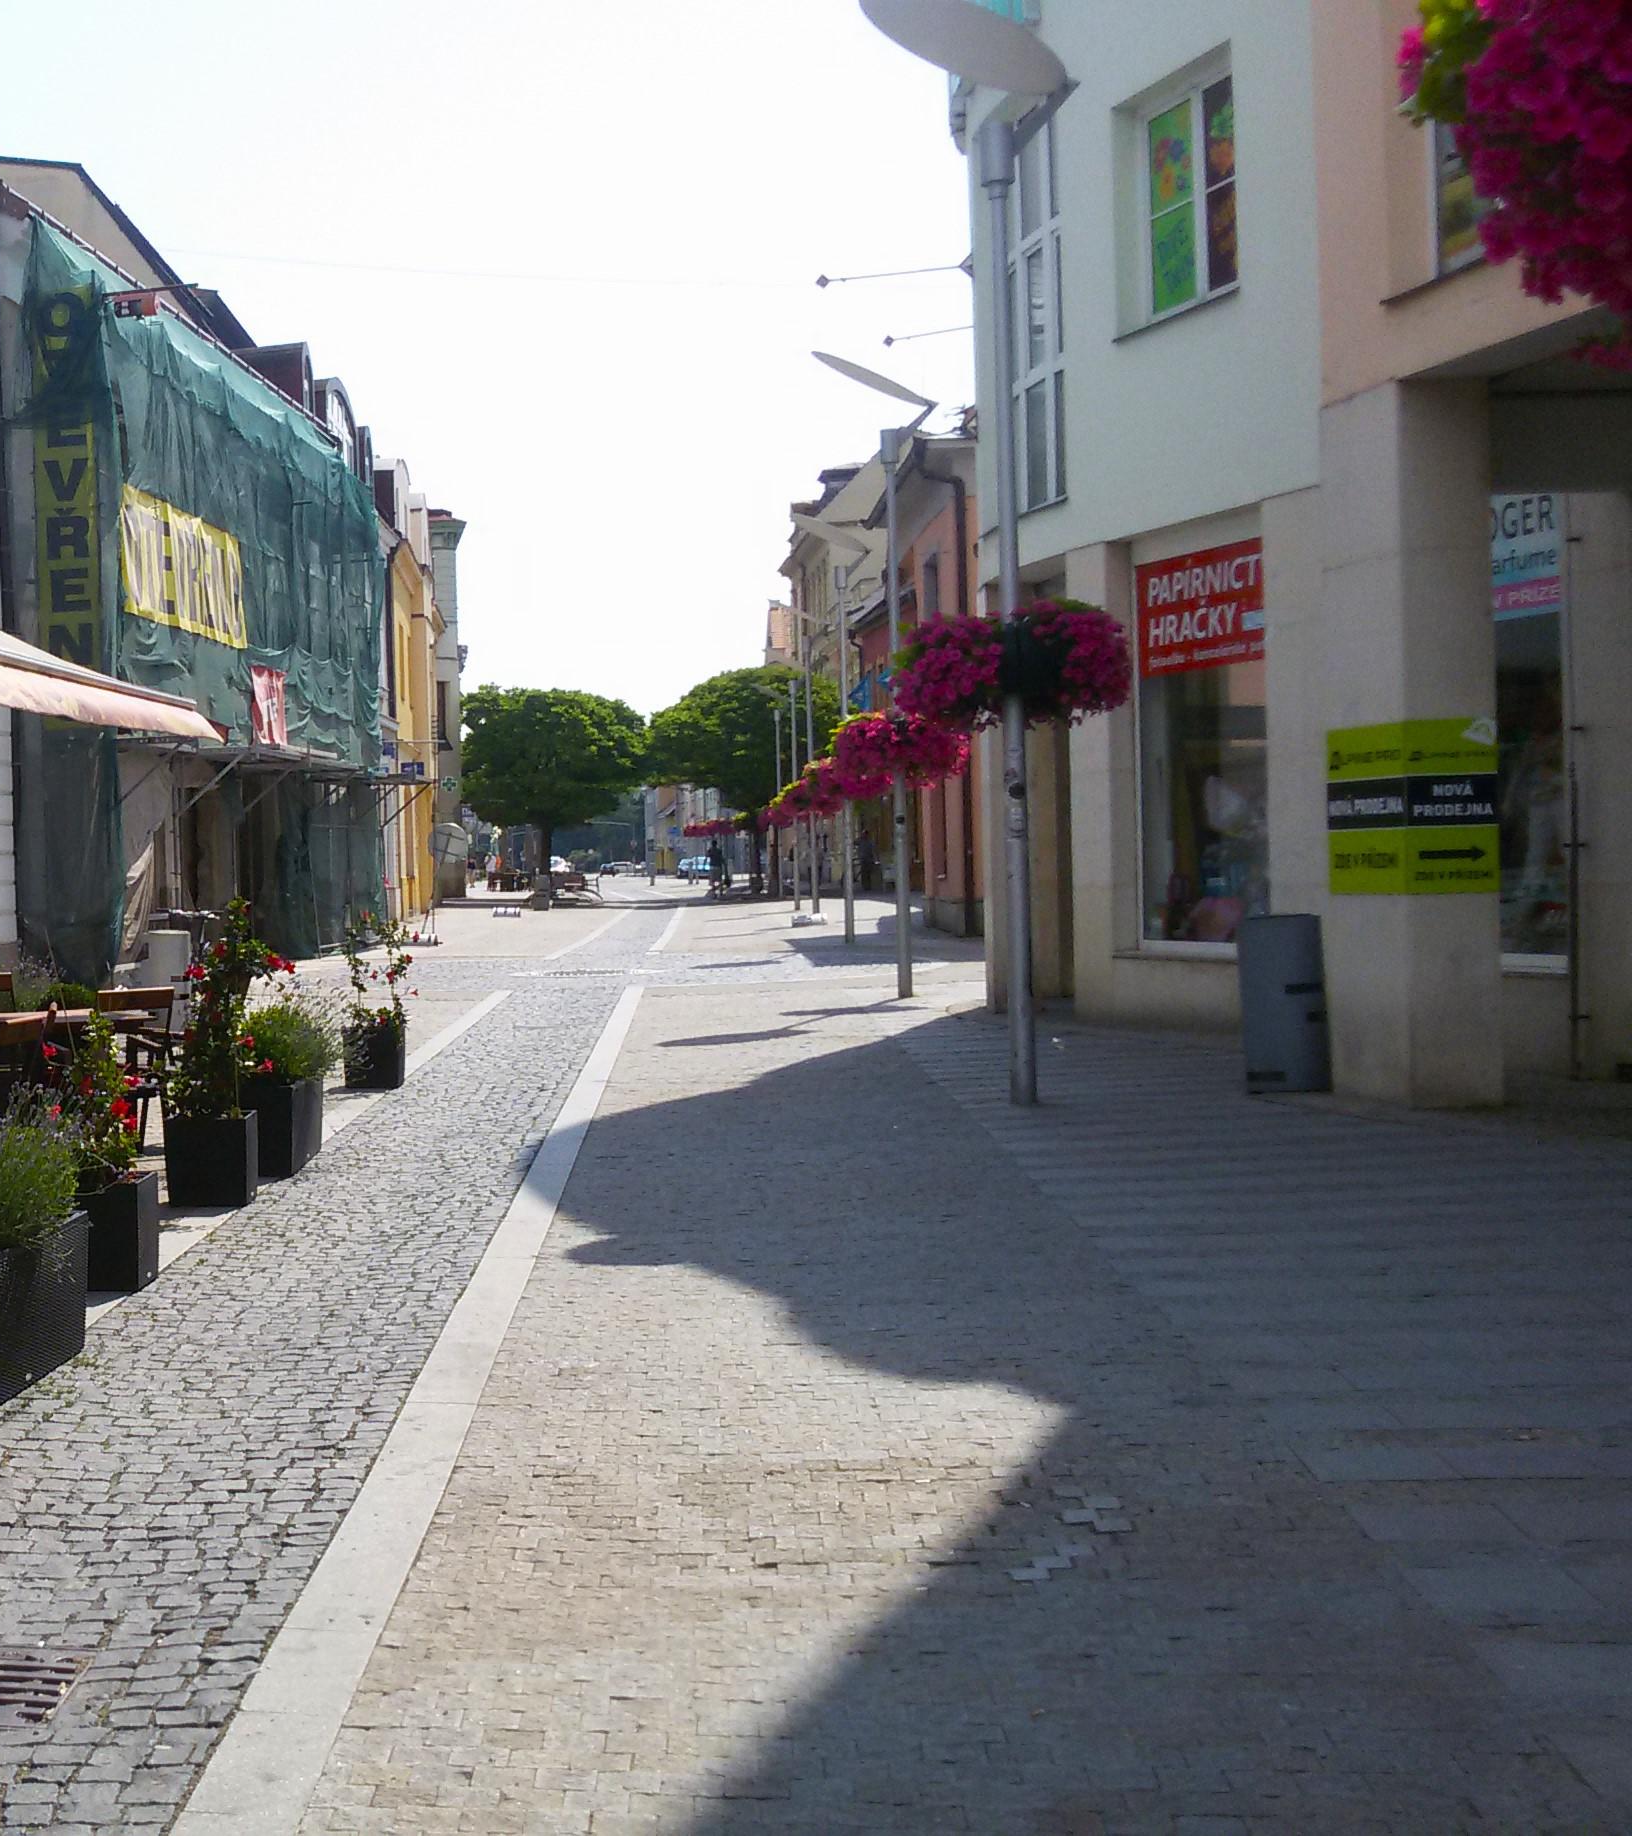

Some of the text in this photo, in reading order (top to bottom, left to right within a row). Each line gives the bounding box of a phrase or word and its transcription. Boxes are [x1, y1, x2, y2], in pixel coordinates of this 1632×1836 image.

[1148, 599, 1238, 648] HRAČKY
[1432, 780, 1474, 797] NOVÁ
[1413, 803, 1494, 817] PRODEJNA
